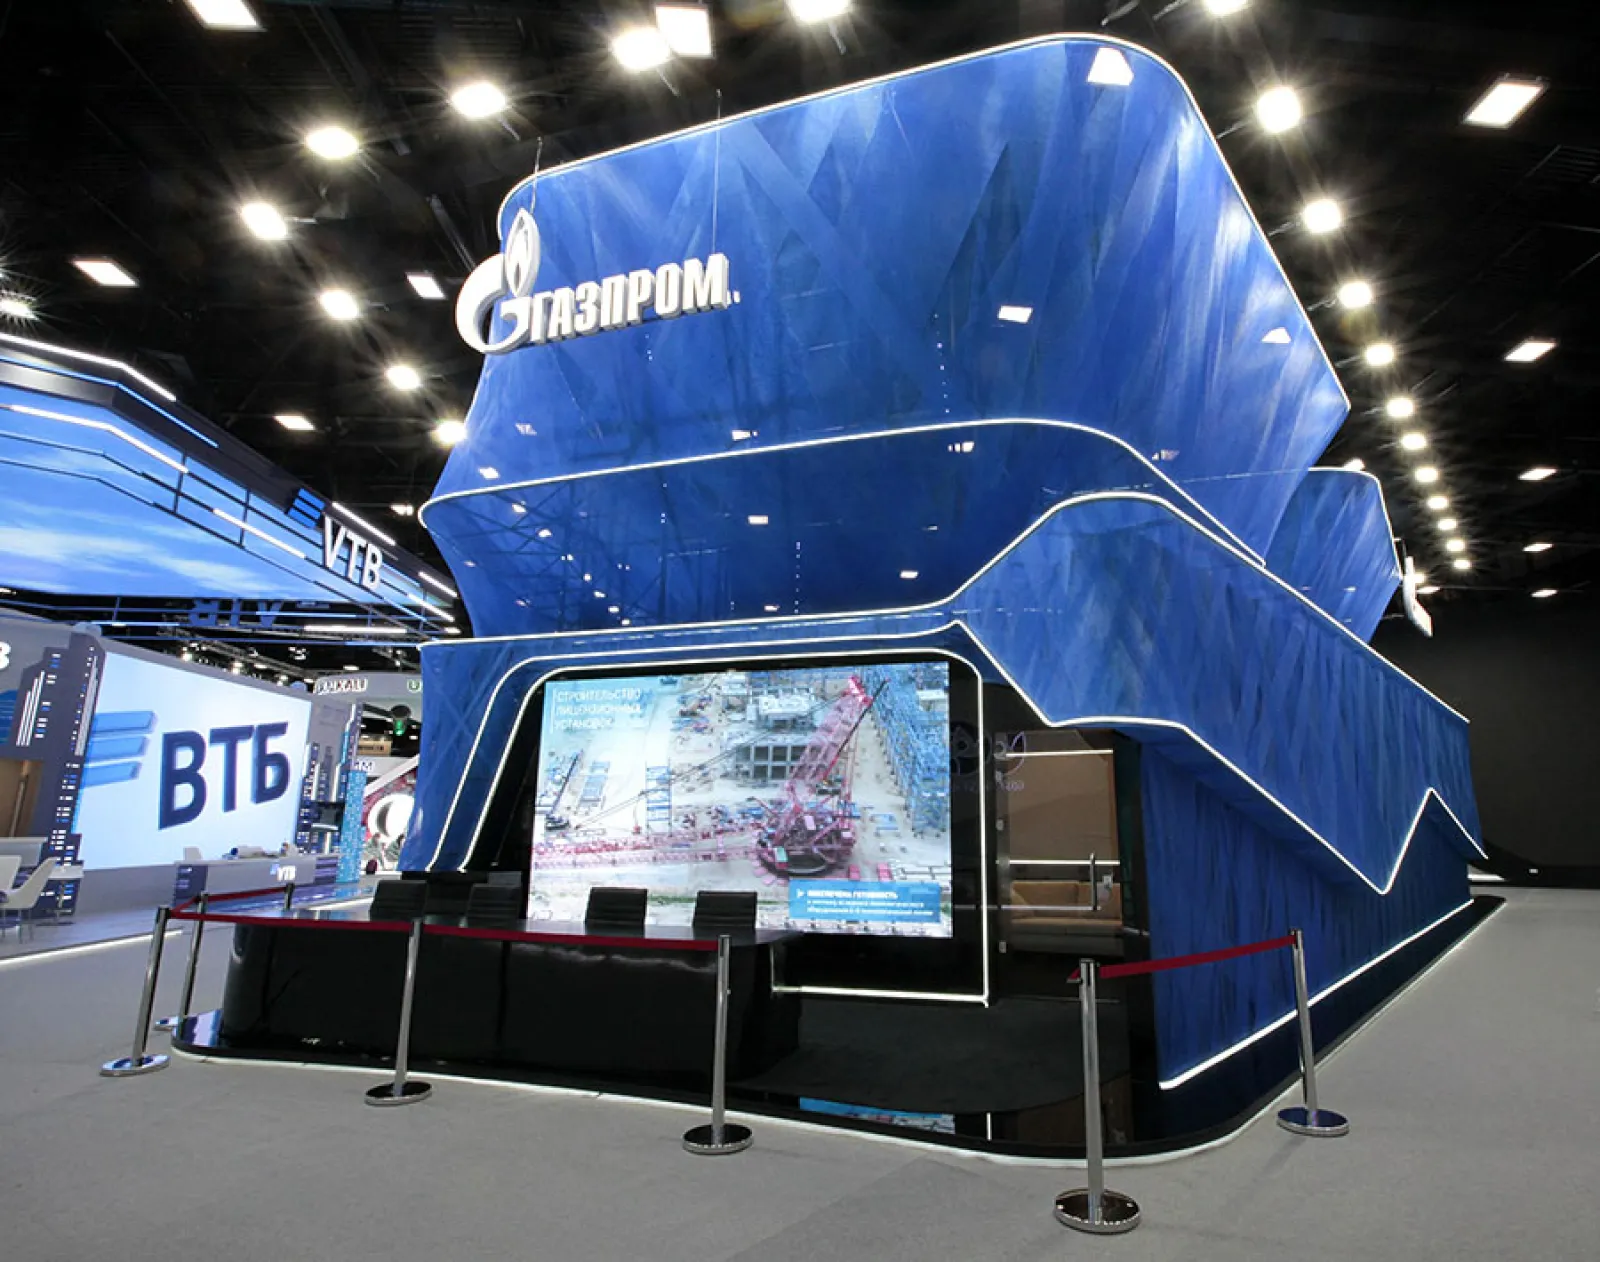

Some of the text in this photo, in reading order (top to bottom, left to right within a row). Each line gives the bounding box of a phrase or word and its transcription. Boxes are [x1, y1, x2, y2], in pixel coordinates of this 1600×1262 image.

[530, 253, 730, 345] ГАЗПРОМ
[322, 514, 383, 589] VTB
[157, 720, 291, 831] ВТБ
